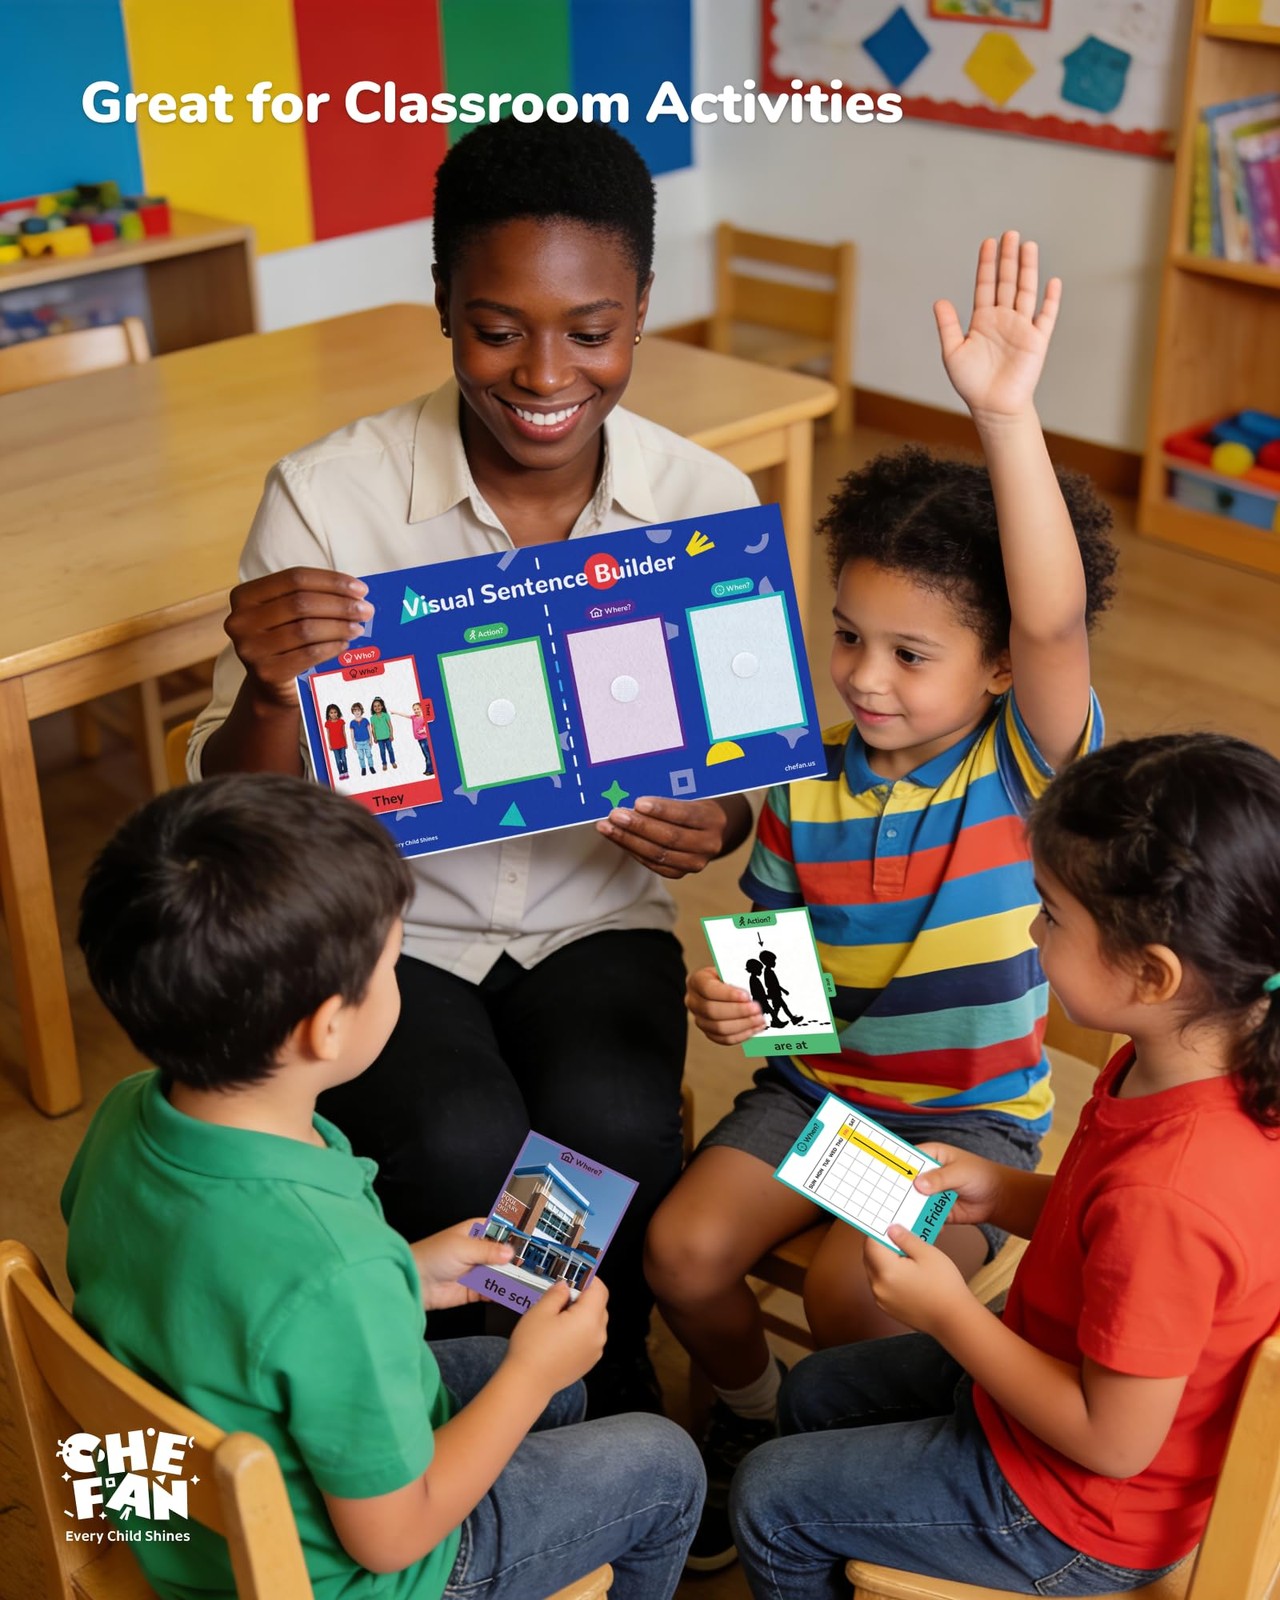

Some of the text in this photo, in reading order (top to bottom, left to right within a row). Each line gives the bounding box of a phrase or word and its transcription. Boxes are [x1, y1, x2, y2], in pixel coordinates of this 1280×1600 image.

[402, 554, 676, 618] Visual Sentence Builder
[725, 581, 751, 593] When?
[604, 603, 632, 615] Where?
[477, 626, 504, 639] Action?
[353, 650, 376, 661] Who?
[358, 666, 379, 676] Who?
[784, 760, 816, 772] chefan.us
[372, 794, 405, 808] They
[404, 838, 420, 846] Child
[420, 835, 439, 844] Shines
[746, 915, 772, 925] Action?
[774, 1040, 809, 1051] are at
[803, 1122, 820, 1143] When?
[808, 1178, 818, 1190] SUN
[814, 1167, 825, 1180] MON
[822, 1157, 831, 1168] TUE
[828, 1147, 838, 1158] WED
[835, 1136, 844, 1147] THU
[848, 1118, 856, 1127] SAT
[575, 1158, 603, 1177] Where?
[920, 1191, 951, 1242] on Friday.
[484, 1278, 532, 1309] the sch
